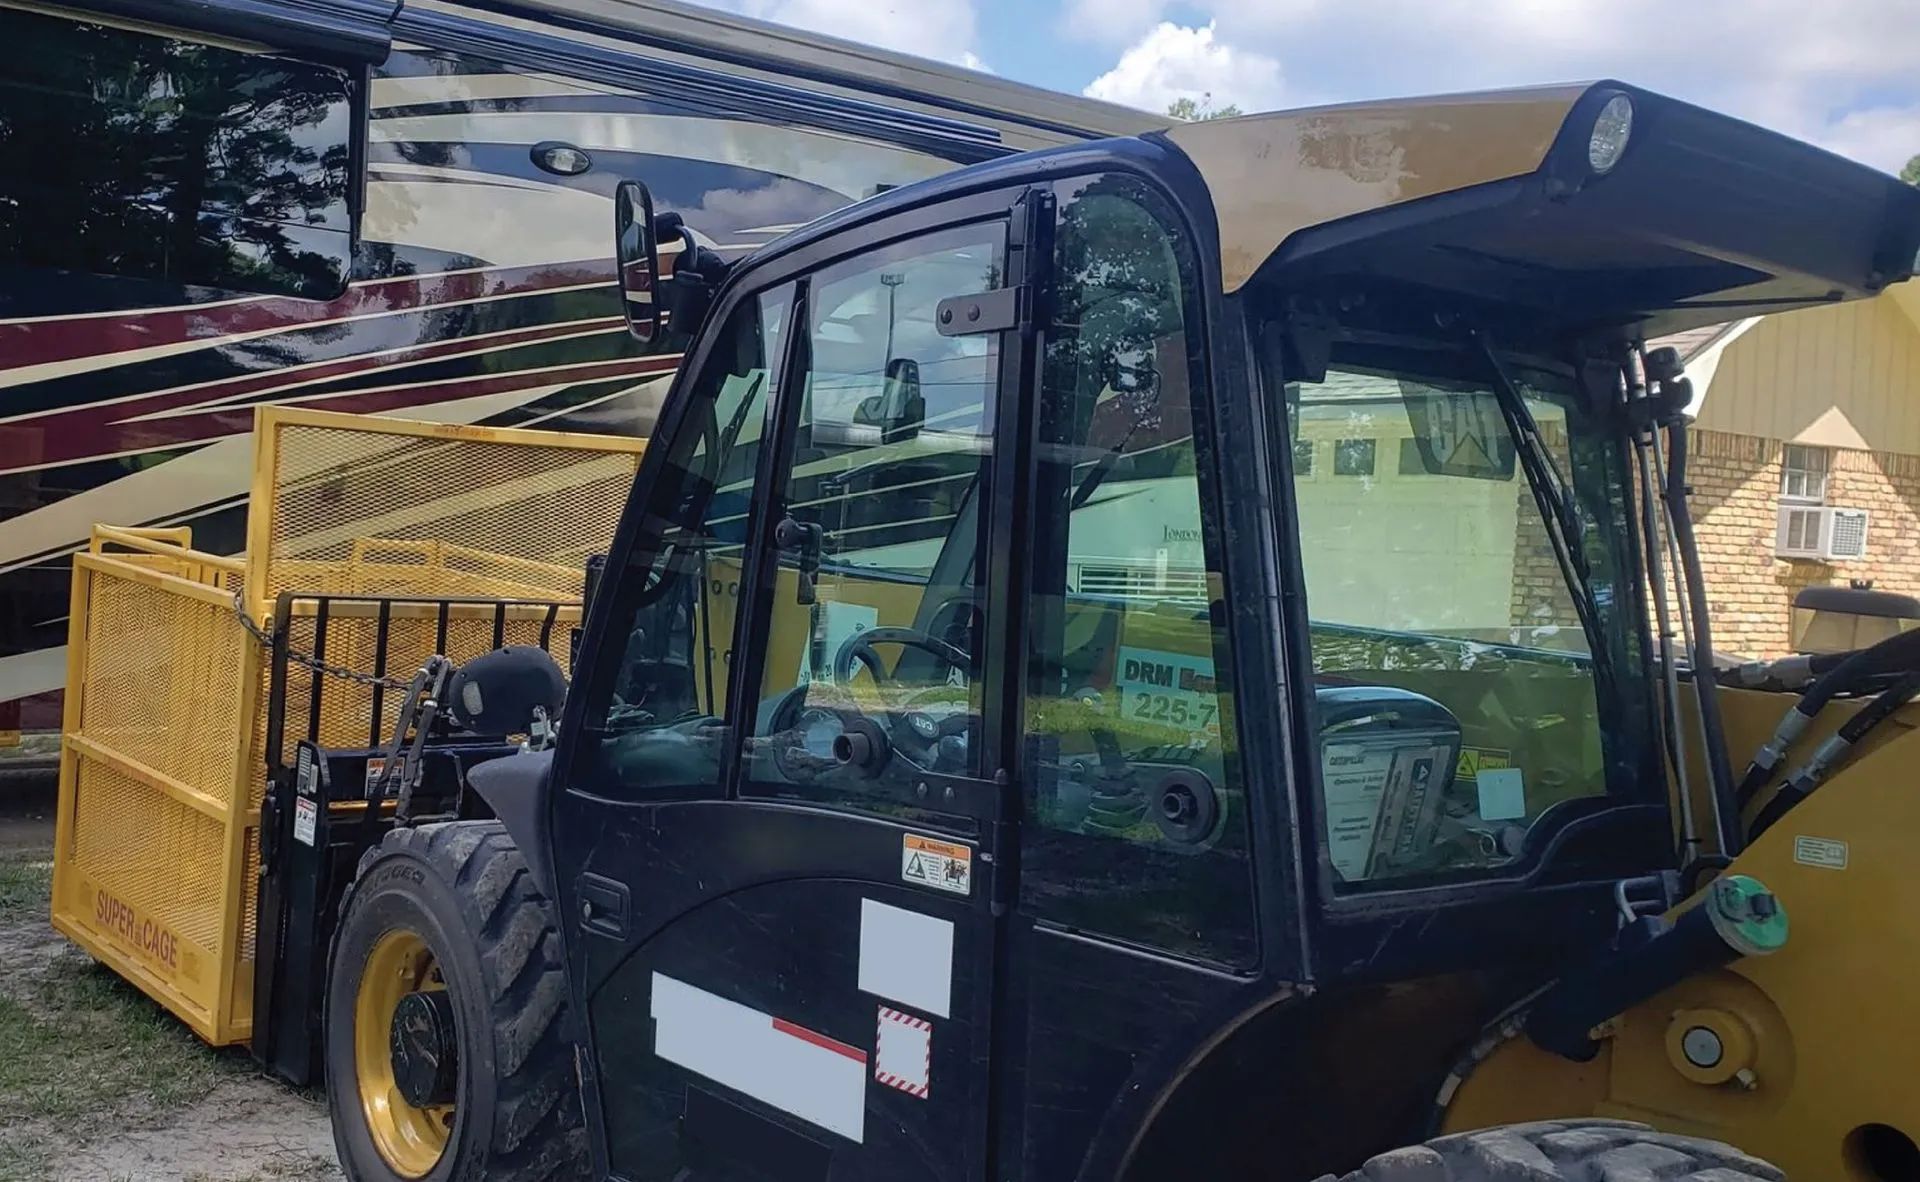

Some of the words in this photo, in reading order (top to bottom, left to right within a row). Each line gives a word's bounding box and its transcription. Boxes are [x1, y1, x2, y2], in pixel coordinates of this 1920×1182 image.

[1125, 659, 1173, 688] DRM
[1134, 693, 1217, 728] 225-7
[97, 889, 135, 939] SUPER
[143, 919, 178, 969] CAGE
